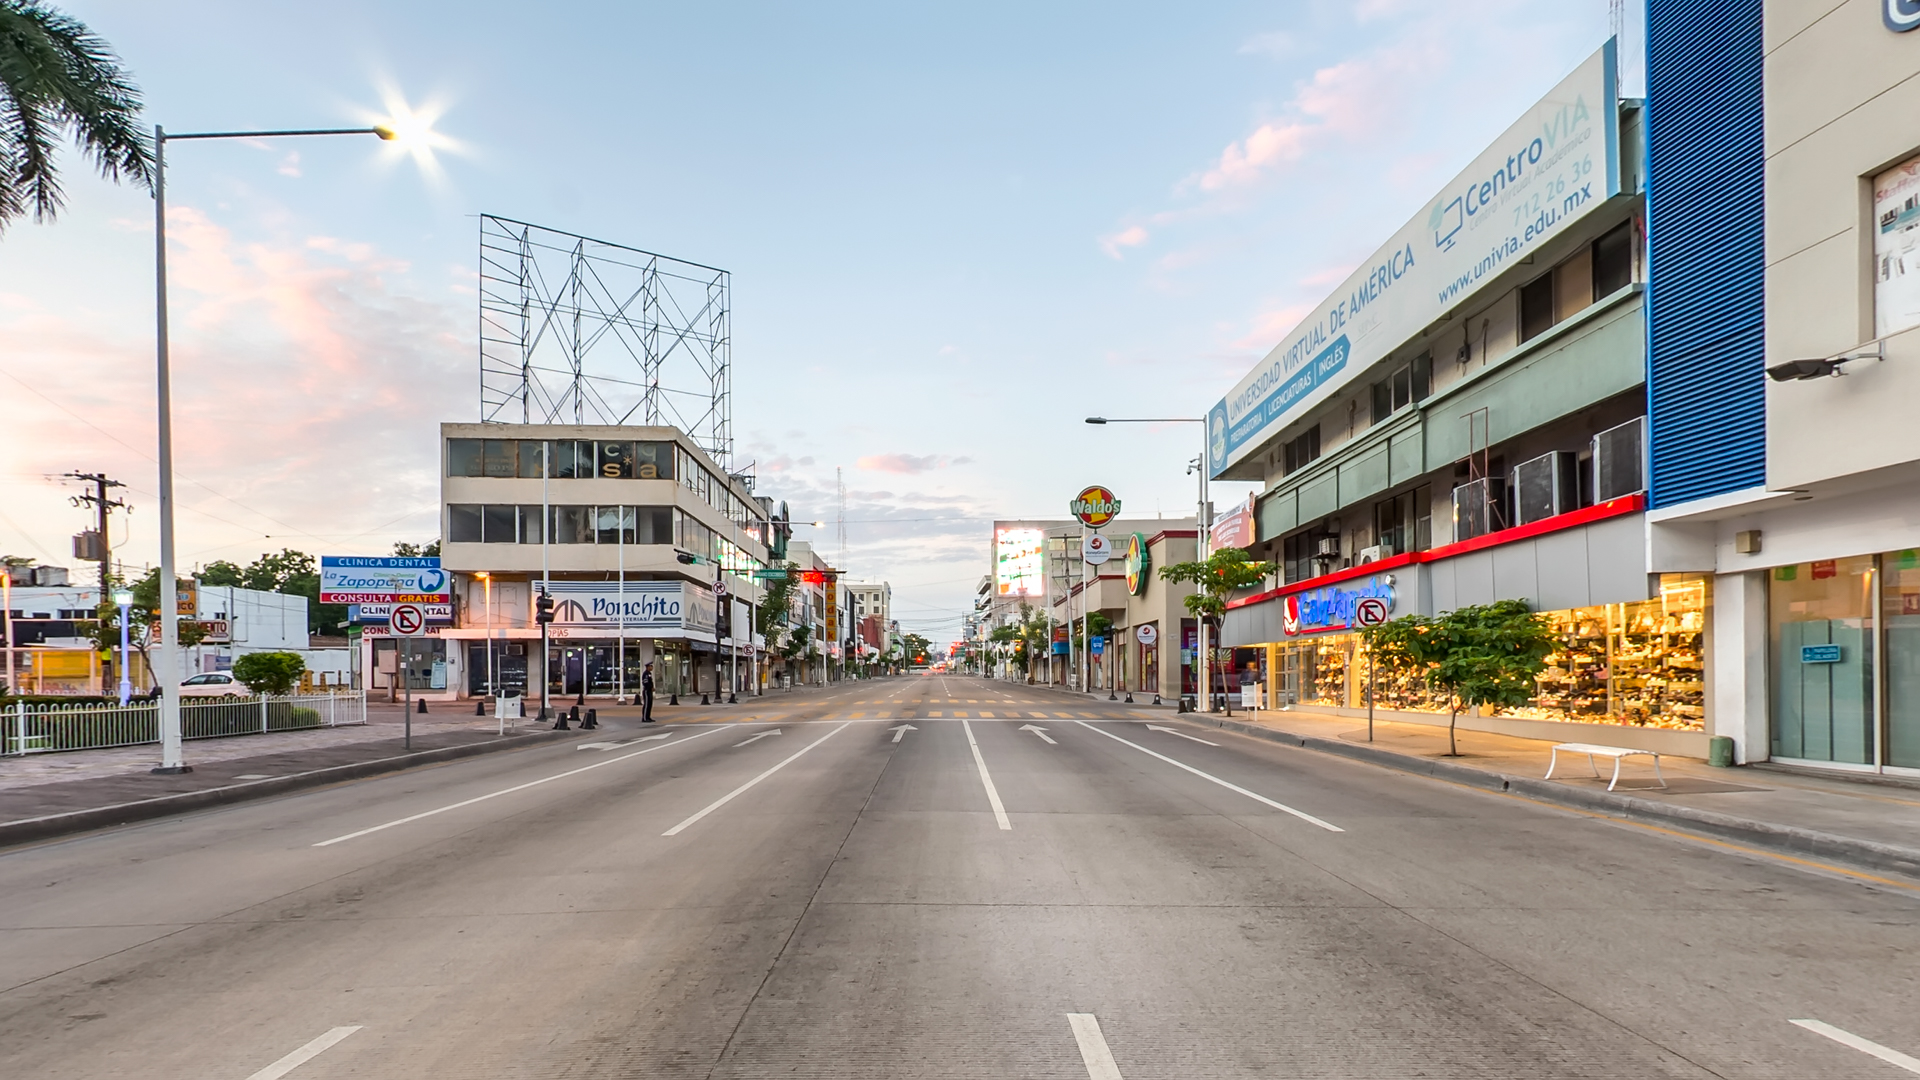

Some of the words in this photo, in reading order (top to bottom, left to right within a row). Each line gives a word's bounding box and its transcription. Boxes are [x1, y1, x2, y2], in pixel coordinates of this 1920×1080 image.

[1513, 192, 1541, 227] 712
[1545, 174, 1566, 205] 26
[1571, 153, 1593, 184] 36
[1438, 182, 1592, 305] www.univia.edu.mx
[1229, 361, 1281, 421] UNIVERSIDAD
[1282, 316, 1327, 374] VIRTUAL
[1330, 299, 1347, 336] DE
[1349, 243, 1415, 320] AMÉRICA
[1230, 413, 1263, 446] PREPARATORIA
[1268, 372, 1312, 416] LICENCIATURAS
[1318, 344, 1345, 377] INGLÉS
[1072, 499, 1120, 514] Waldo's
[338, 557, 383, 567] CLINICA
[389, 557, 433, 567] DENTAL
[324, 570, 337, 580] La
[330, 593, 392, 603] CONSULTA
[399, 594, 441, 603] GRATIS
[592, 594, 680, 621] Ponchito
[363, 626, 390, 635] CONS
